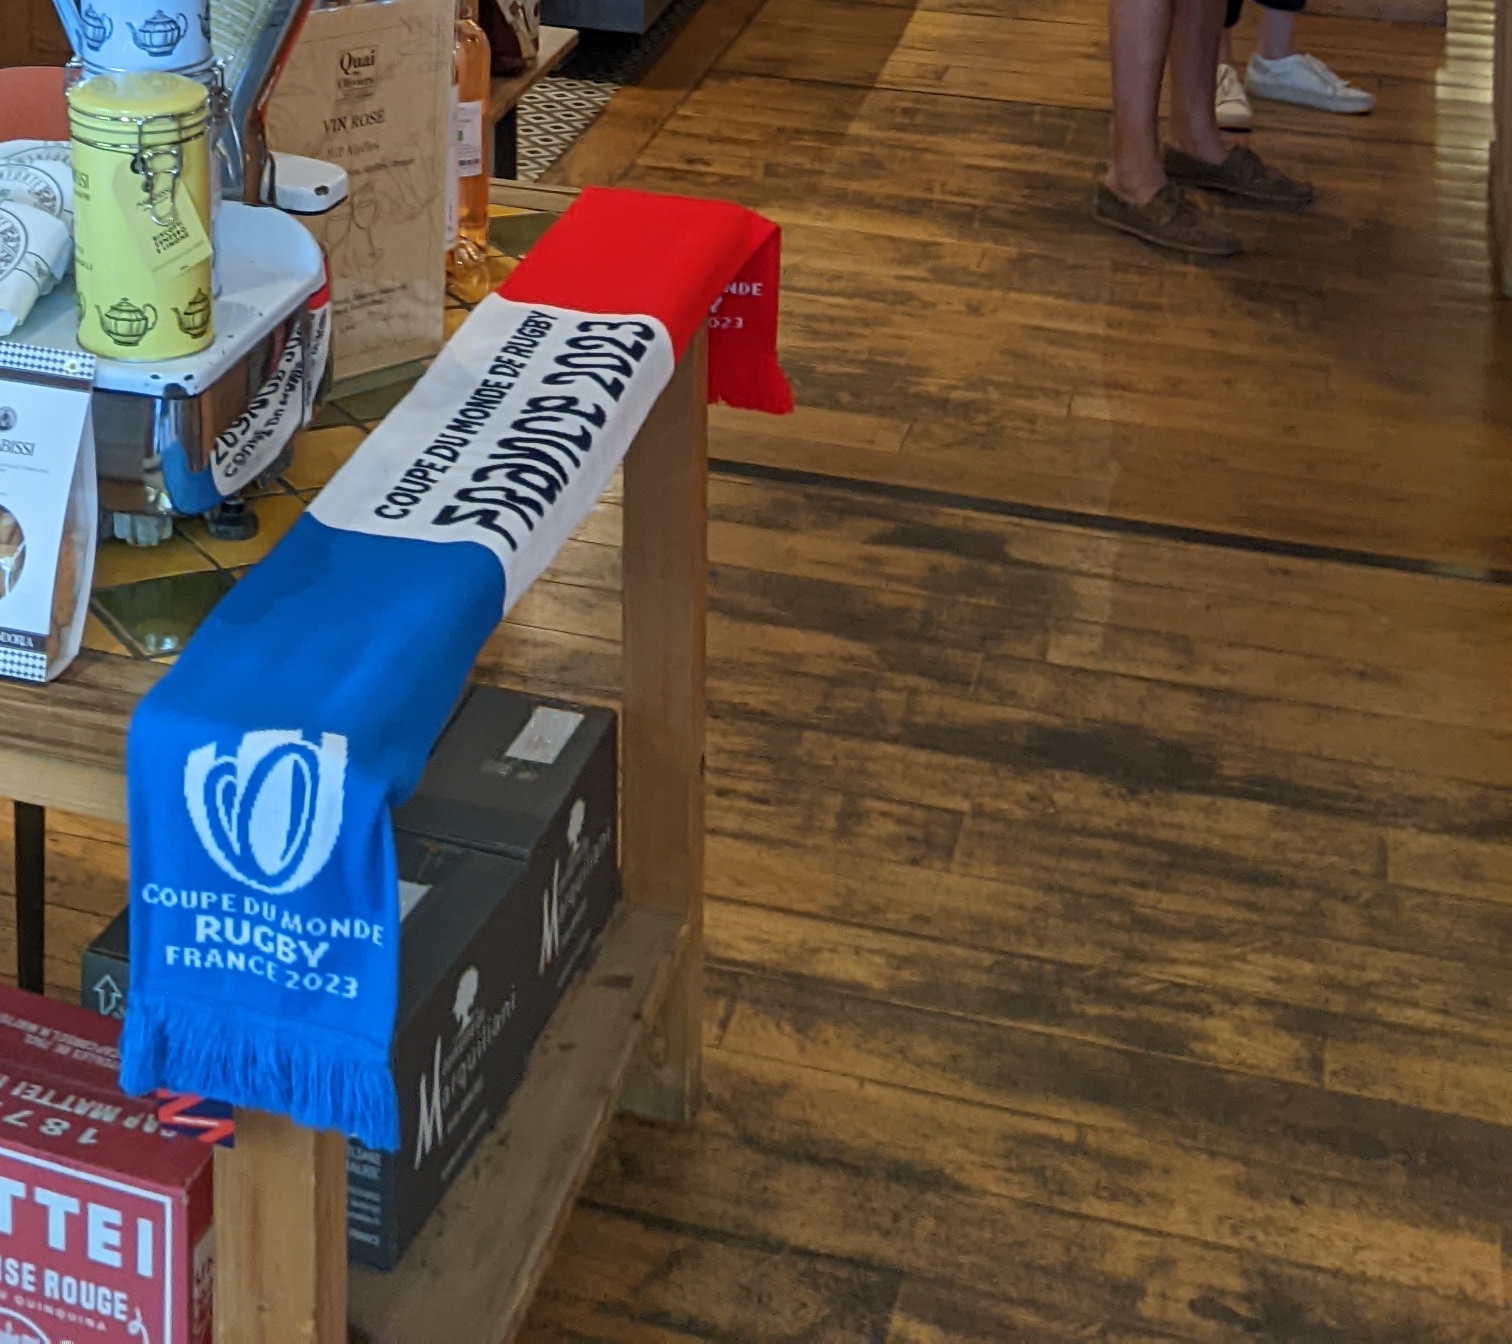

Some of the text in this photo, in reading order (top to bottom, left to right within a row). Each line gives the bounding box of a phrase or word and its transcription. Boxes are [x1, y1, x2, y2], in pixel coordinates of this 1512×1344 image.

[339, 49, 376, 75] Quai
[322, 114, 348, 135] VIN
[724, 282, 763, 296] NDE
[542, 320, 656, 402] 2023
[375, 310, 558, 520] COUPE DU MONDE DE RUGBY
[141, 882, 385, 946] COUPE DU MONDE
[195, 914, 330, 969] RUGBY
[165, 945, 359, 1000] FRANCE 2023
[12, 1081, 121, 1124] MATTEI
[43, 1268, 129, 1322] ROUGE
